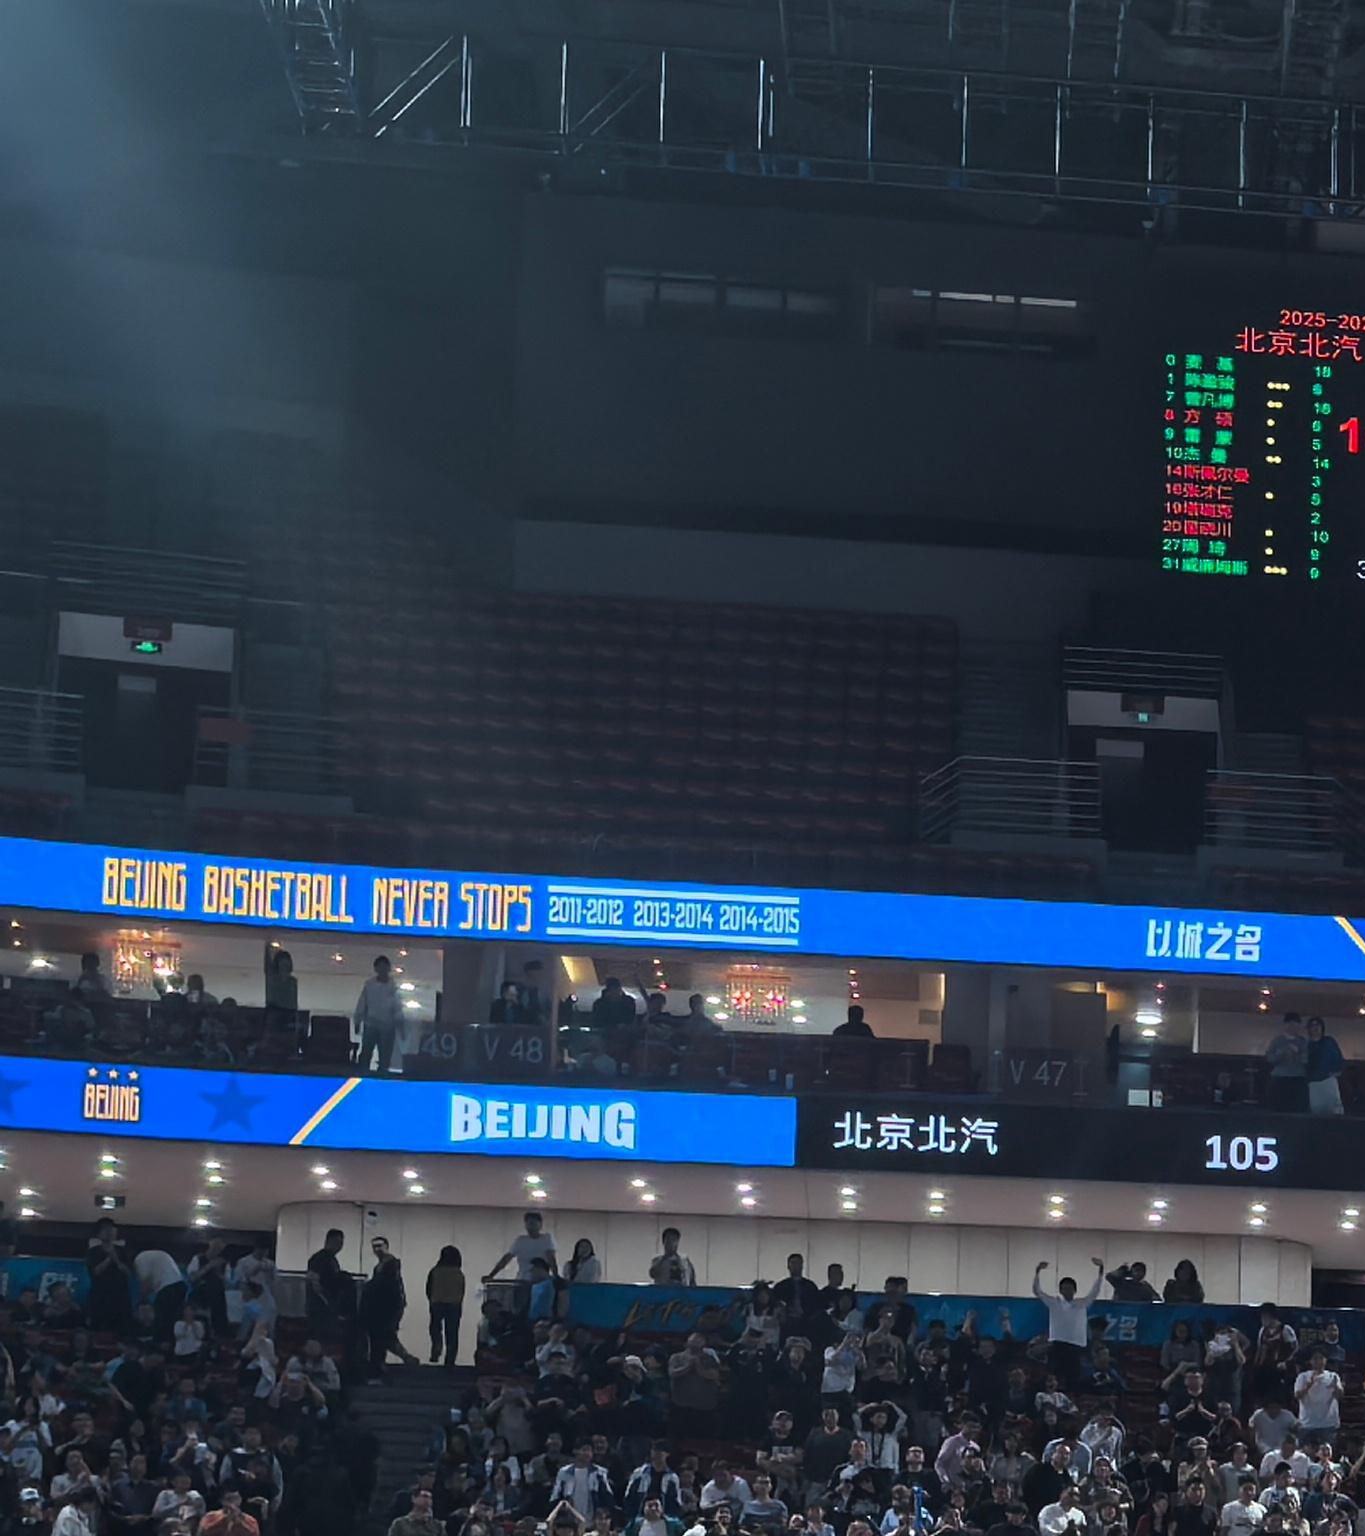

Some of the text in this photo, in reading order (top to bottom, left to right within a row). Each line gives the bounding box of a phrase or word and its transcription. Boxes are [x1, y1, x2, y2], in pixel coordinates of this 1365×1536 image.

[1235, 326, 1363, 362] 北京北汽
[102, 856, 533, 933] BEIJING BASKETBALL NEVER STOPS
[548, 894, 800, 934] 2011-2012 2013-2014 2014-2015
[1146, 919, 1262, 964] 以城之名
[509, 1036, 544, 1064] 48
[1034, 1060, 1066, 1088] 47
[83, 1082, 141, 1123] BEIJING
[450, 1094, 637, 1150] BEIJING
[833, 1110, 999, 1157] 北京北汽
[1205, 1135, 1279, 1171] 105
